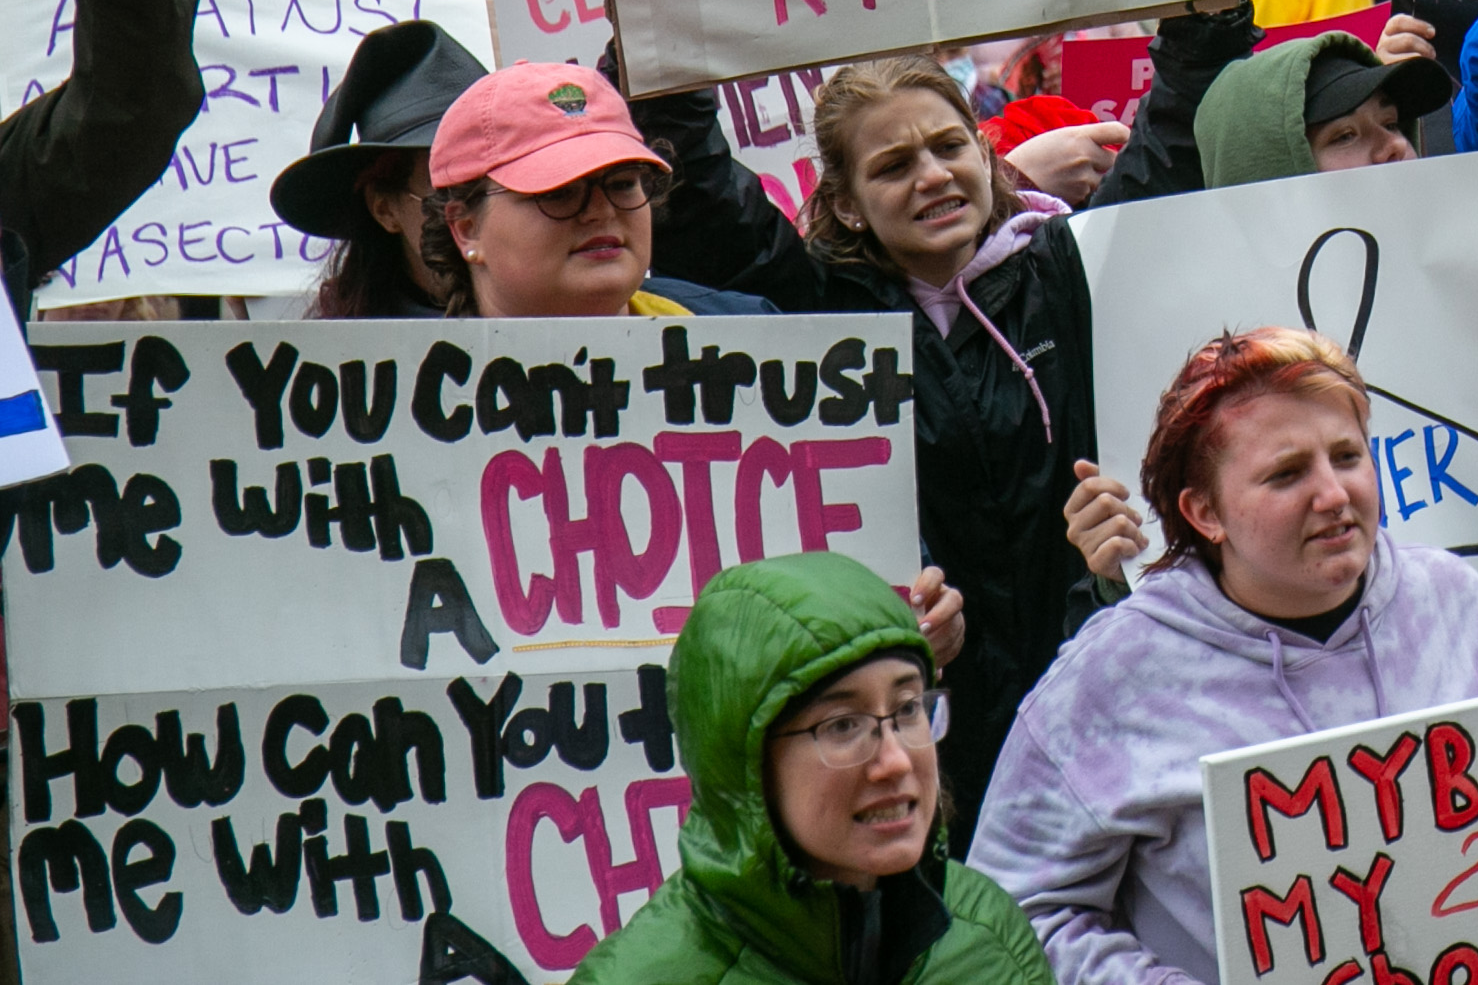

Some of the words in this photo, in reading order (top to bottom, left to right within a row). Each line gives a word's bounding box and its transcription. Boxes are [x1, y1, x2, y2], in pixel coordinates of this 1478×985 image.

[28, 335, 191, 448] If
[411, 340, 631, 444] Can't
[642, 325, 914, 426] trust
[1019, 339, 1056, 364] Columbia
[480, 430, 911, 636] CHOICE
[399, 557, 501, 671] A
[15, 698, 246, 824] How
[262, 693, 447, 814] Can
[1244, 730, 1422, 864] MY
[420, 912, 533, 985] A
[1239, 851, 1396, 978] MY
